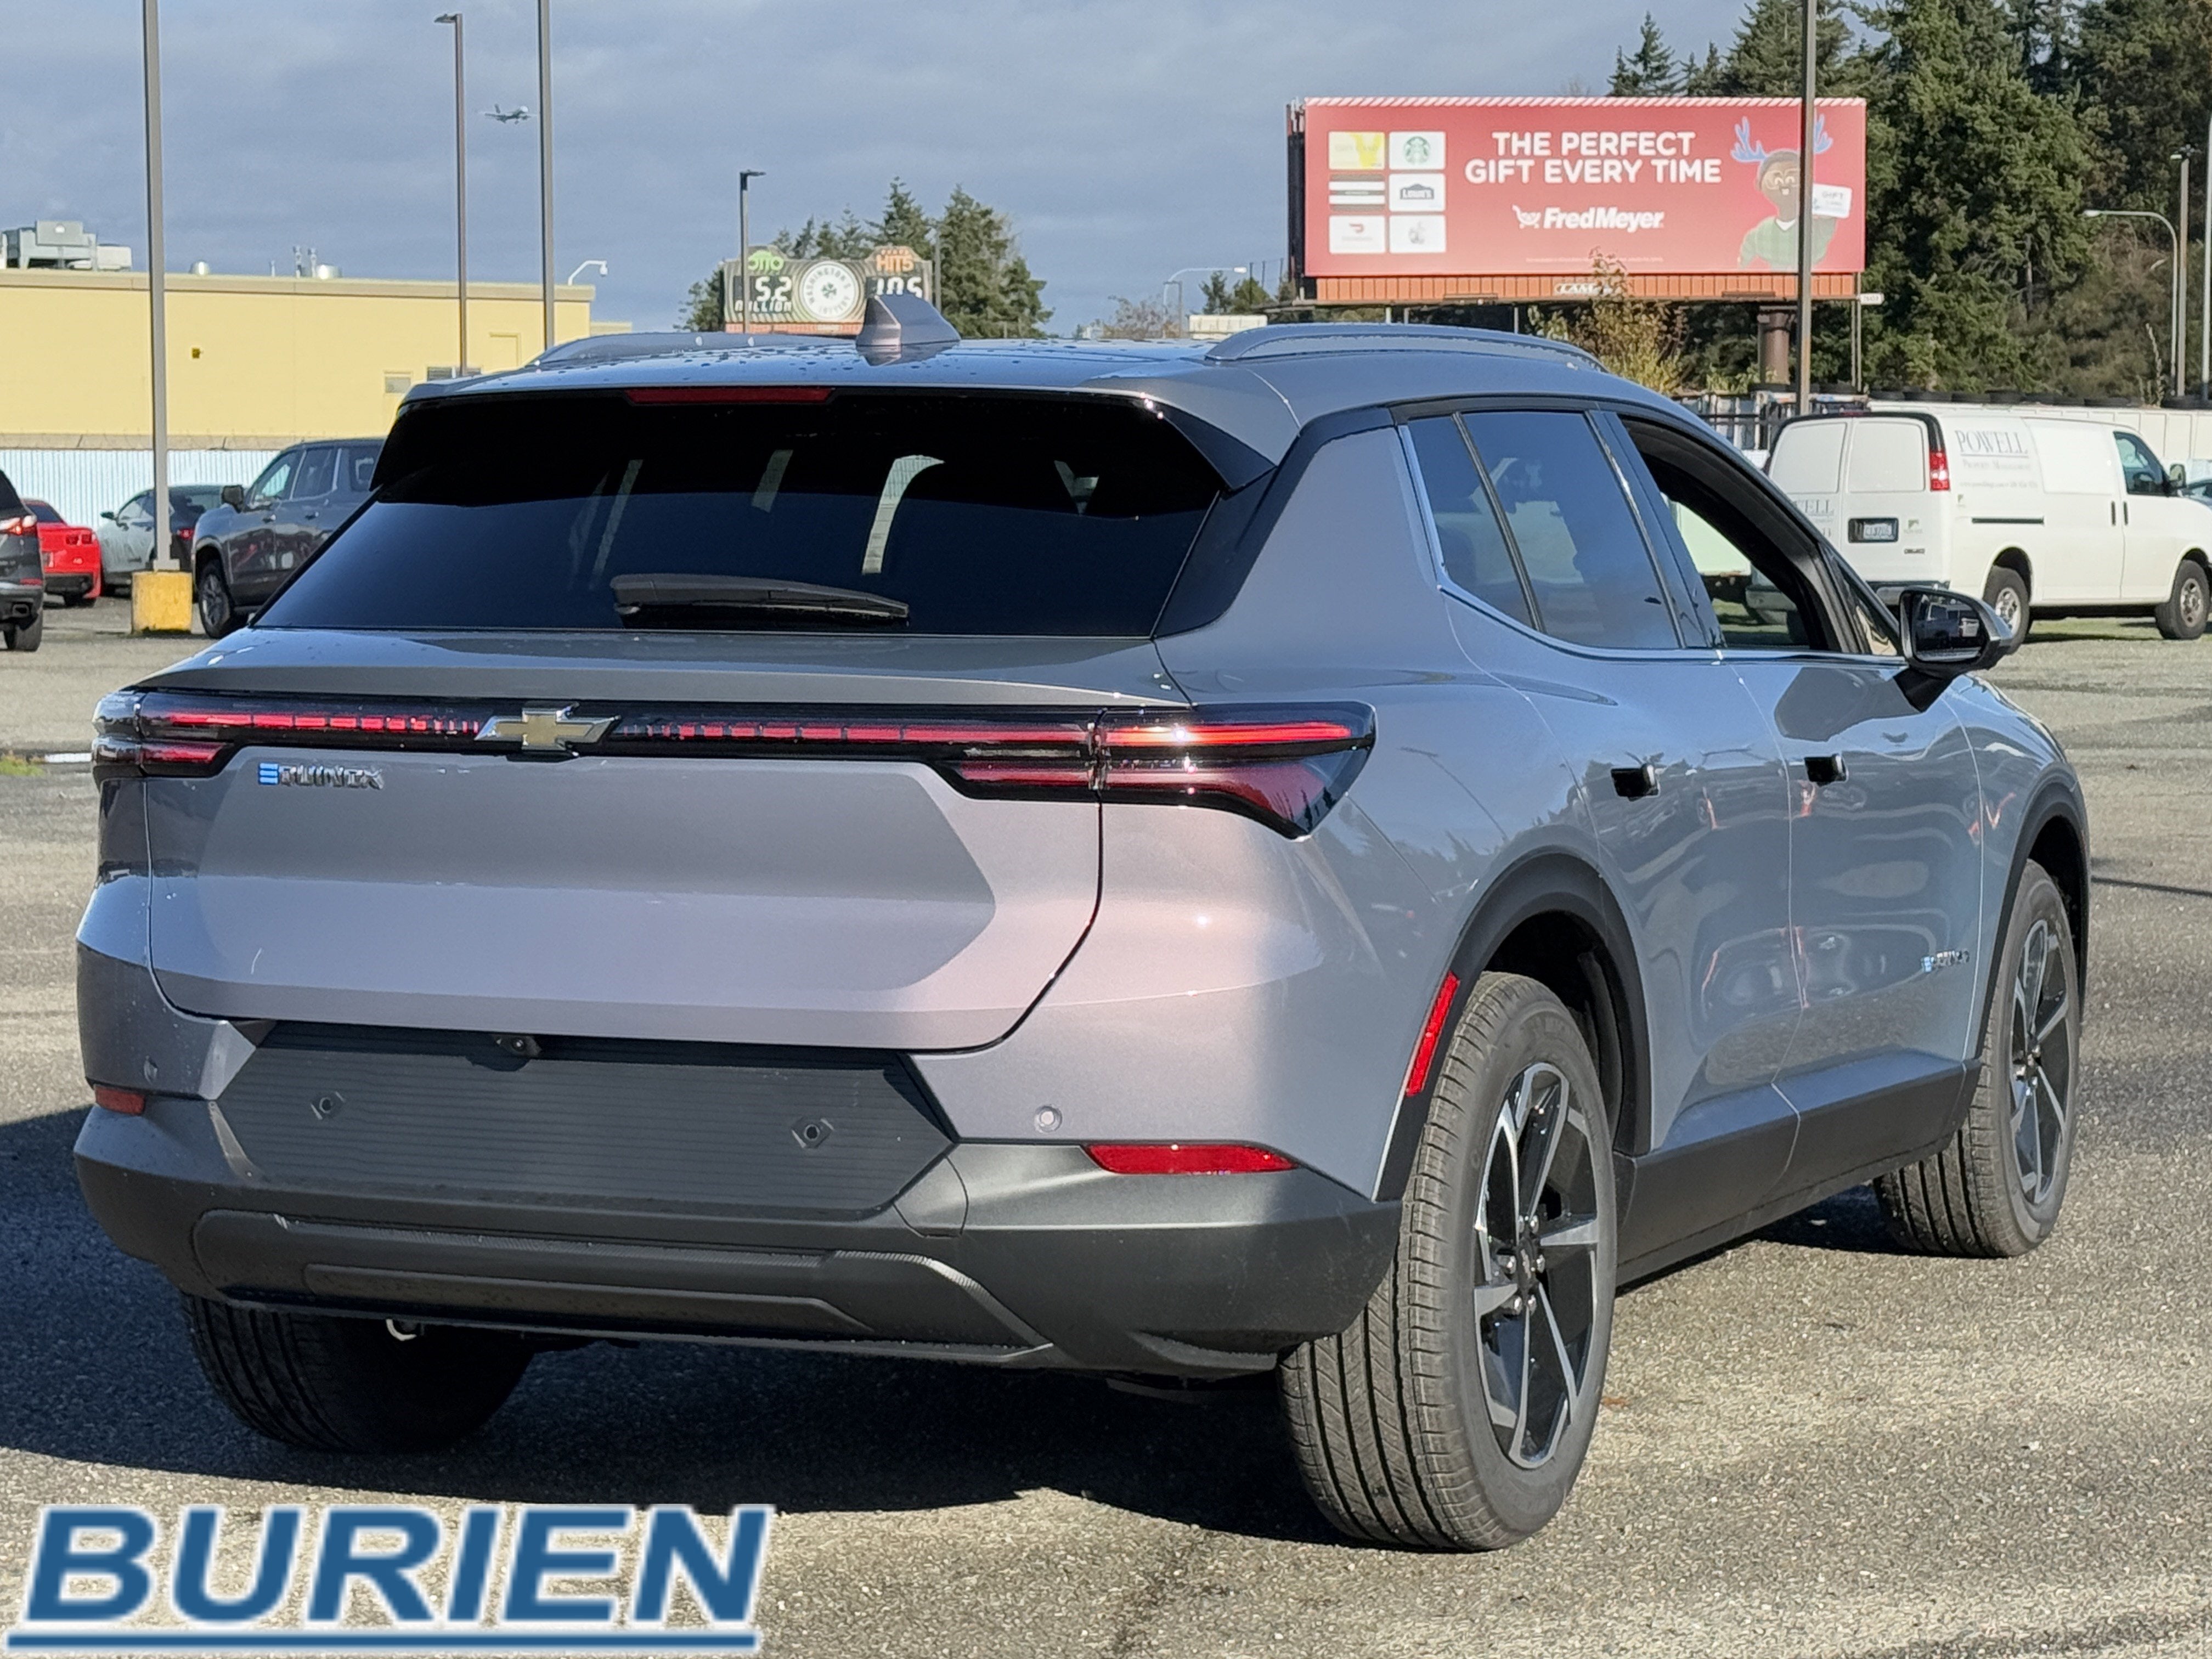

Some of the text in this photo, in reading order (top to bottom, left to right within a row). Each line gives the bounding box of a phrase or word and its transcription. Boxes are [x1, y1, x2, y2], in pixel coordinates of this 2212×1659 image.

[1492, 131, 1696, 156] THE PERFECT
[1464, 159, 1722, 184] GIFT EVERY TIME
[755, 276, 792, 302] 52
[1954, 430, 2029, 454] POWELL
